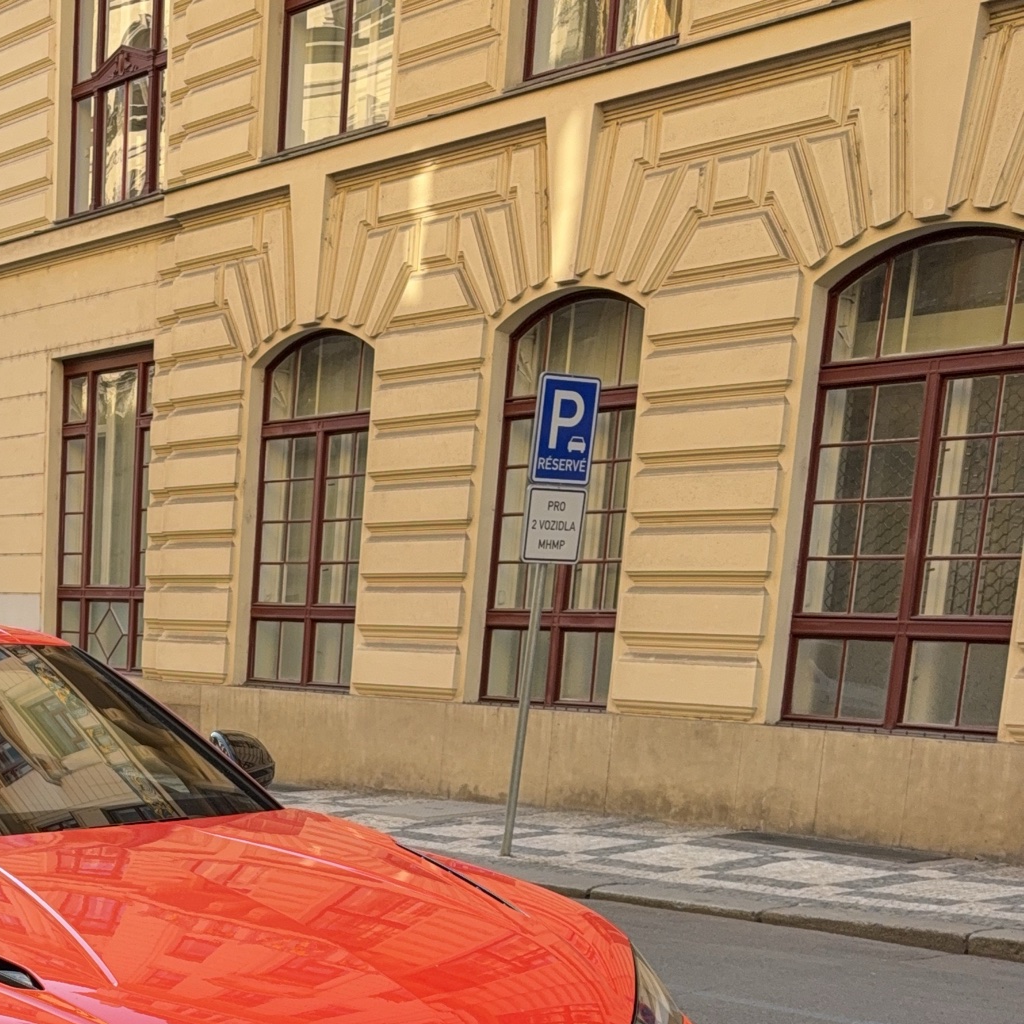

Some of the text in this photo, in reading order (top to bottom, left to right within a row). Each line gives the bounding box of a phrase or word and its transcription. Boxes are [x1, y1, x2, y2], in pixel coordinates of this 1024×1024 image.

[548, 389, 585, 450] P
[537, 455, 587, 473] RÉSERVÉ
[547, 500, 566, 512] PRO
[531, 519, 576, 532] 2 VOZIDLA
[537, 538, 566, 550] MHMP
